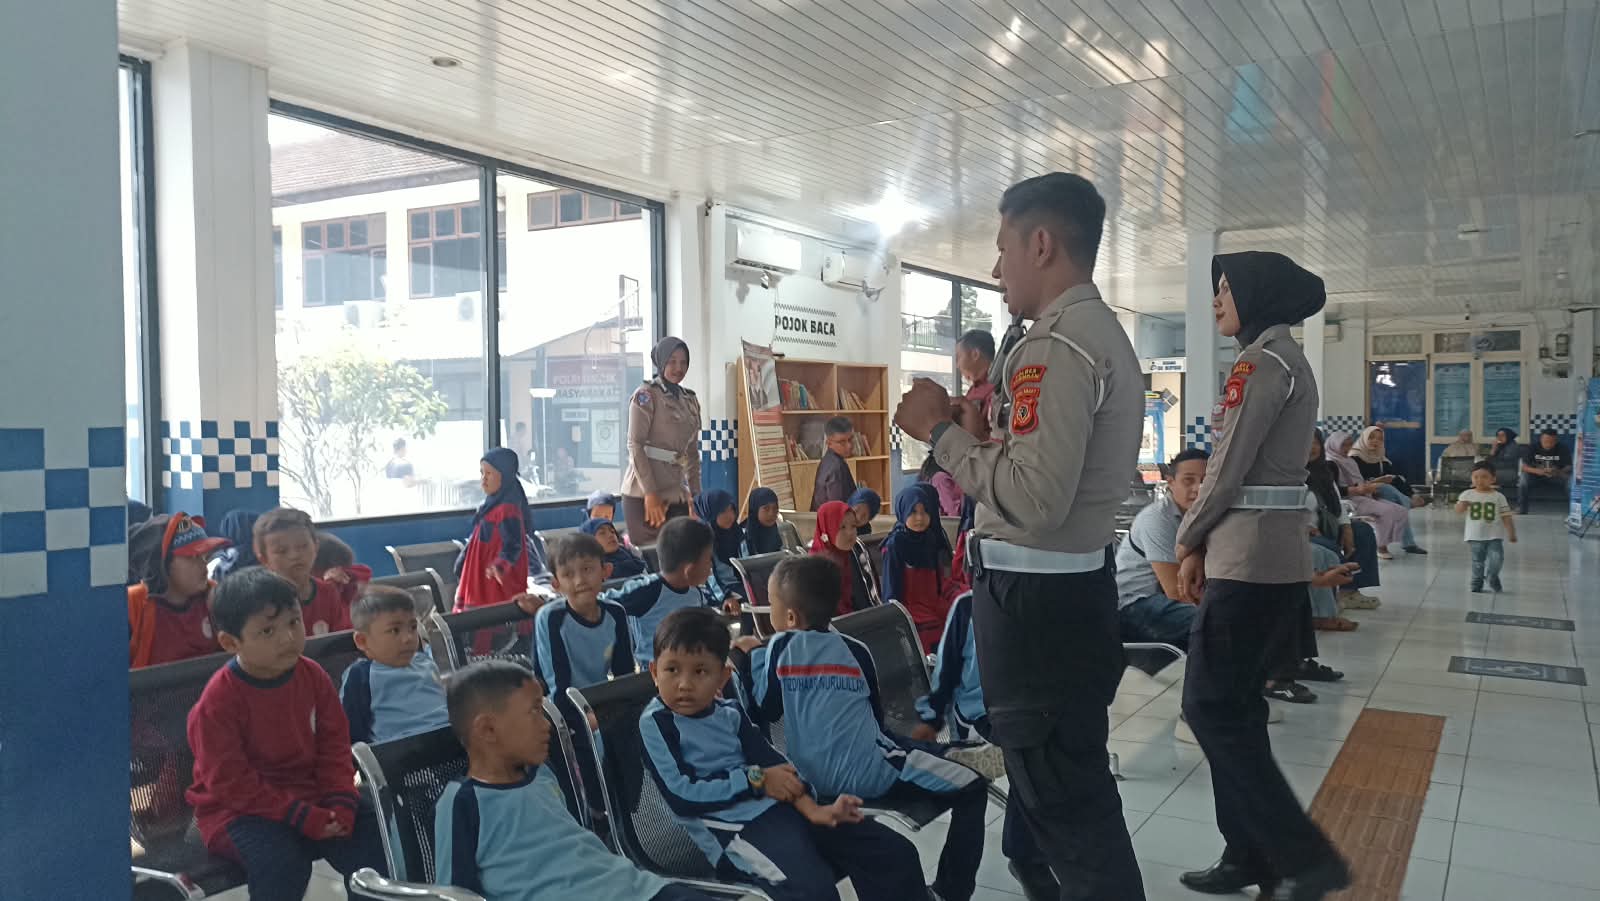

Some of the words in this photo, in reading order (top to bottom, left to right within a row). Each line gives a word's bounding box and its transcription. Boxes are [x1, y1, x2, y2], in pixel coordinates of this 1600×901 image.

[775, 315, 808, 332] POJOK
[810, 320, 836, 336] BACA
[1471, 502, 1495, 521] 88
